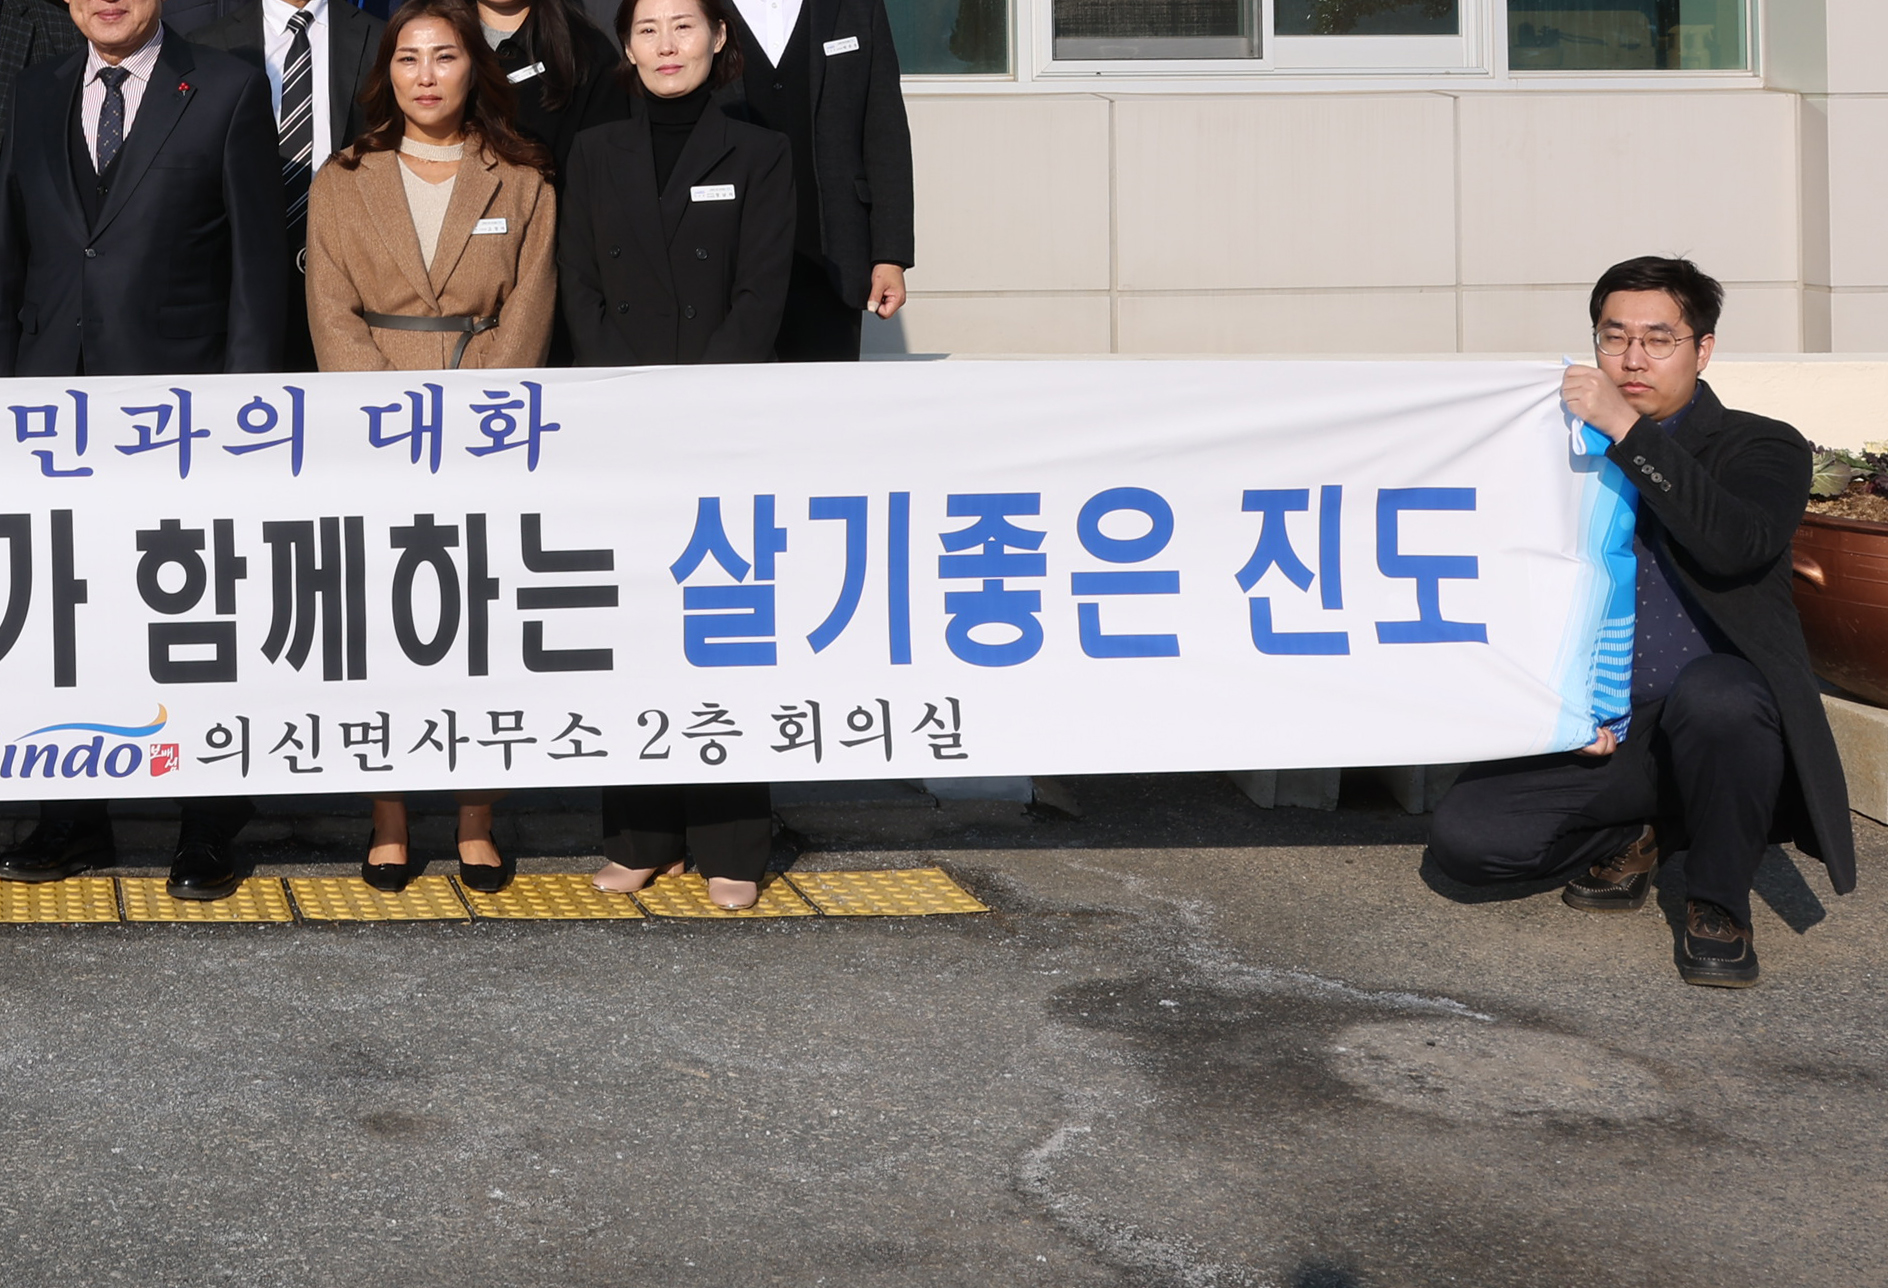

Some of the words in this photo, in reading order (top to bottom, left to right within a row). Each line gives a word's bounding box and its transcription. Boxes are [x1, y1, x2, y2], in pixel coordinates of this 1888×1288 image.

[359, 380, 561, 475] 대화
[135, 512, 619, 685] 함께하는
[669, 486, 1181, 668] 살기좋은
[1234, 484, 1489, 656] 진도
[196, 708, 609, 778] 의신면사무소
[637, 702, 743, 766] 2층
[770, 696, 969, 764] 회의실
